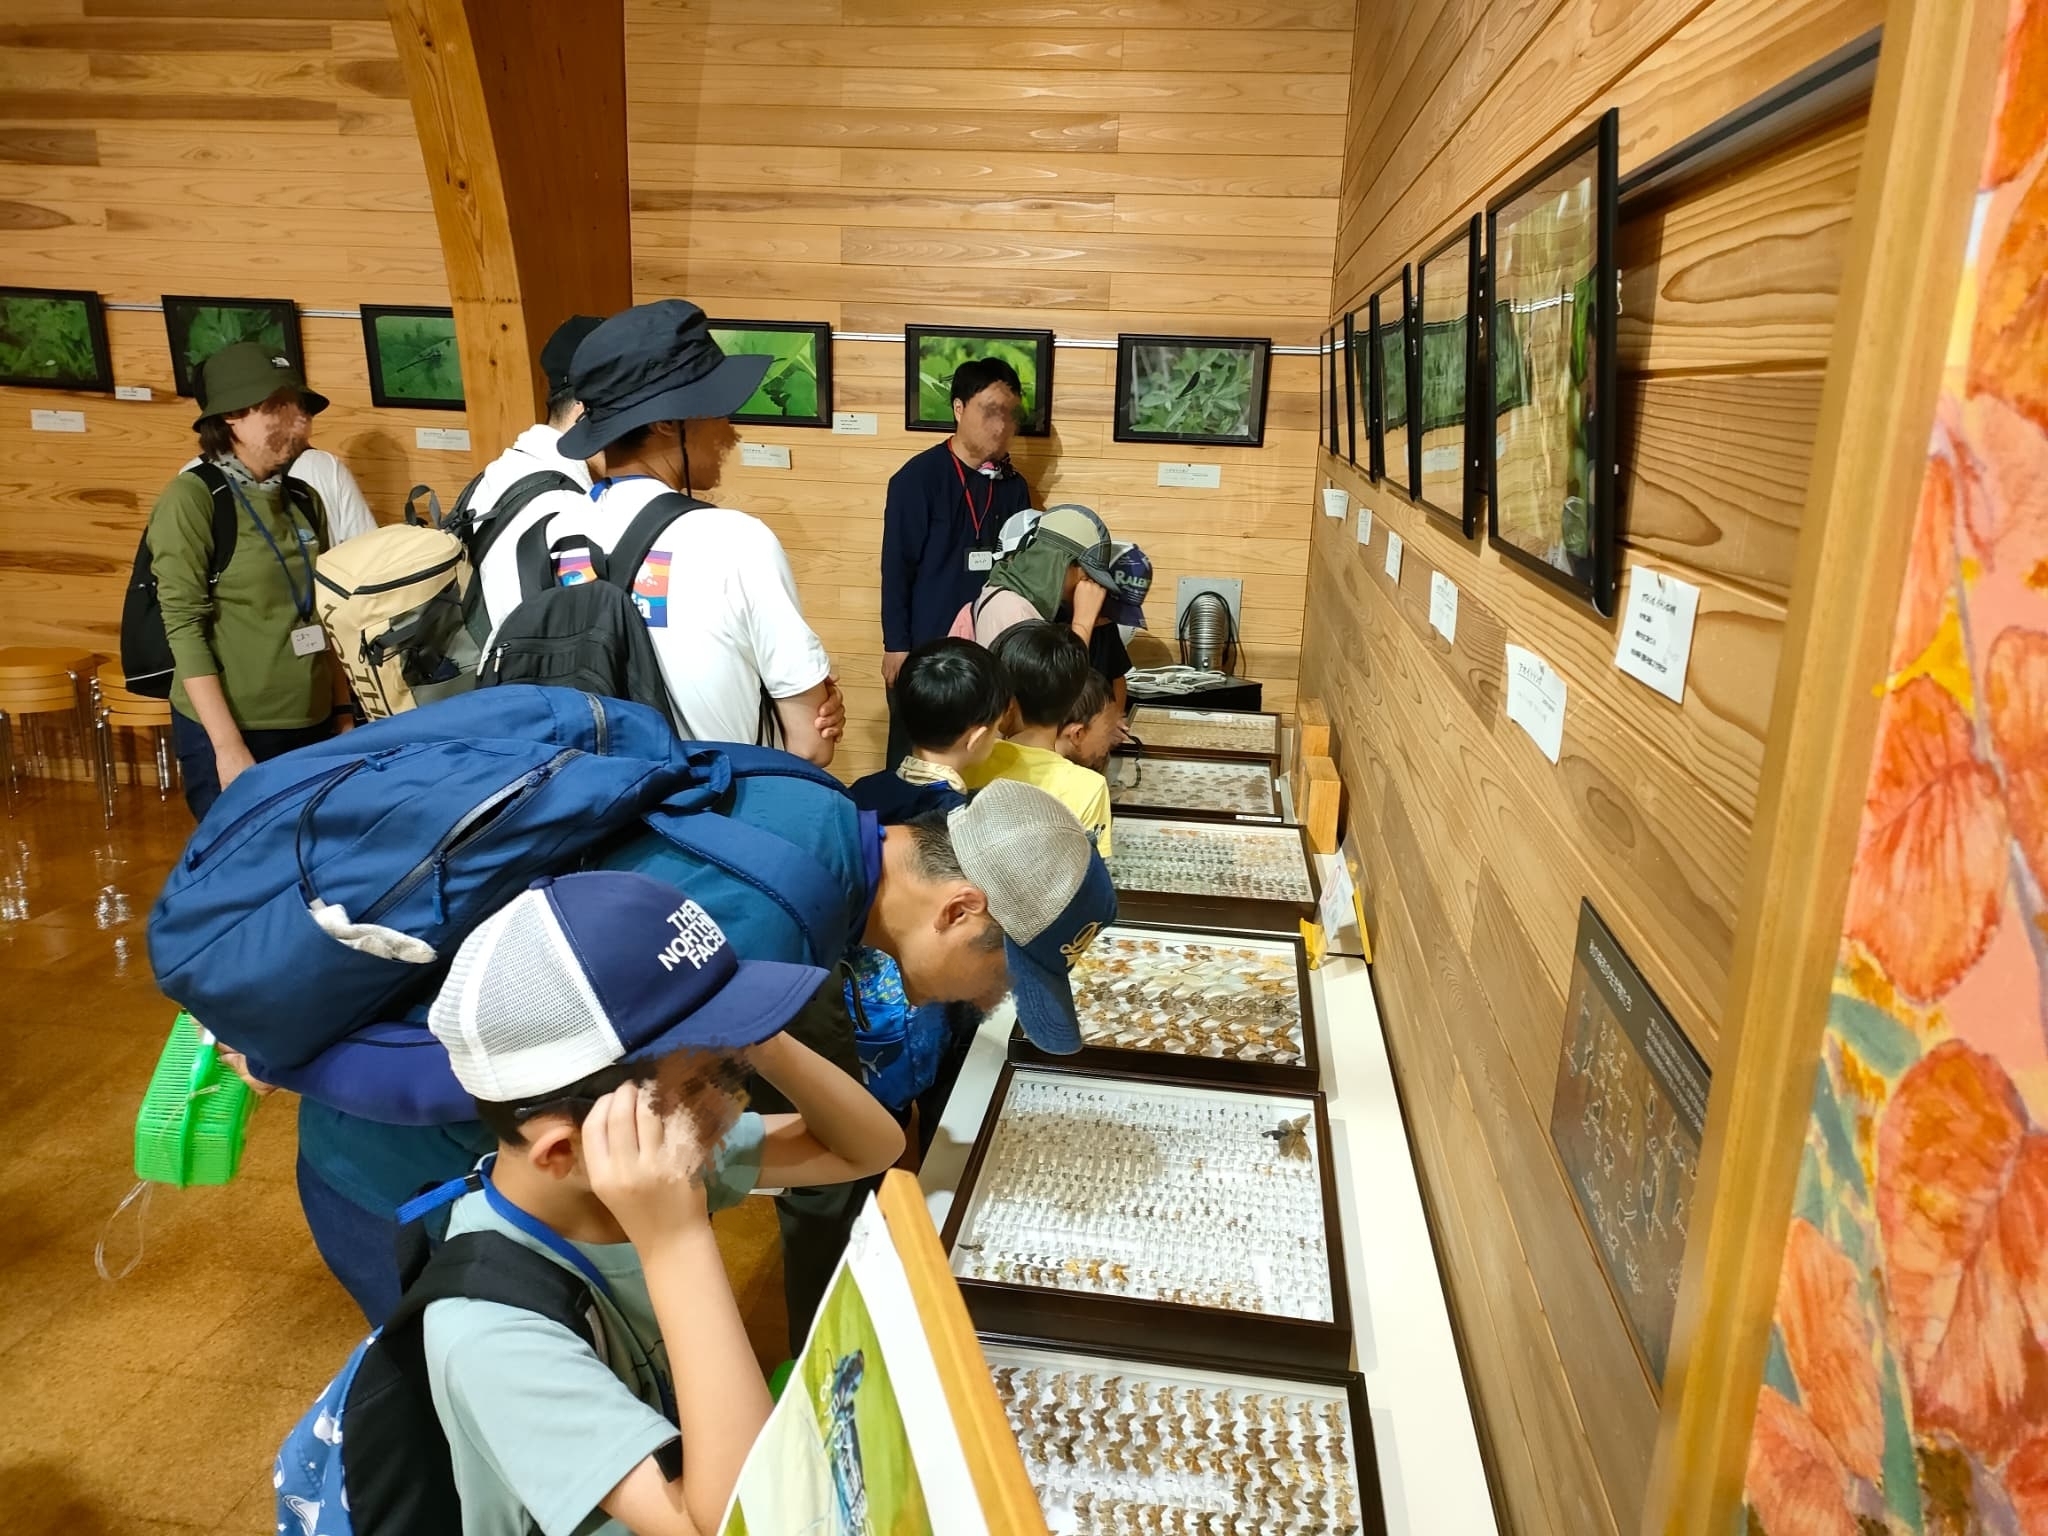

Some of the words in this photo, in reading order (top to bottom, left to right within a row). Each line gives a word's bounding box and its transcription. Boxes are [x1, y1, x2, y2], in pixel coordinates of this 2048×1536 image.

[666, 899, 704, 931] THE
[658, 912, 715, 971] NORTH
[687, 926, 727, 970] FACE
